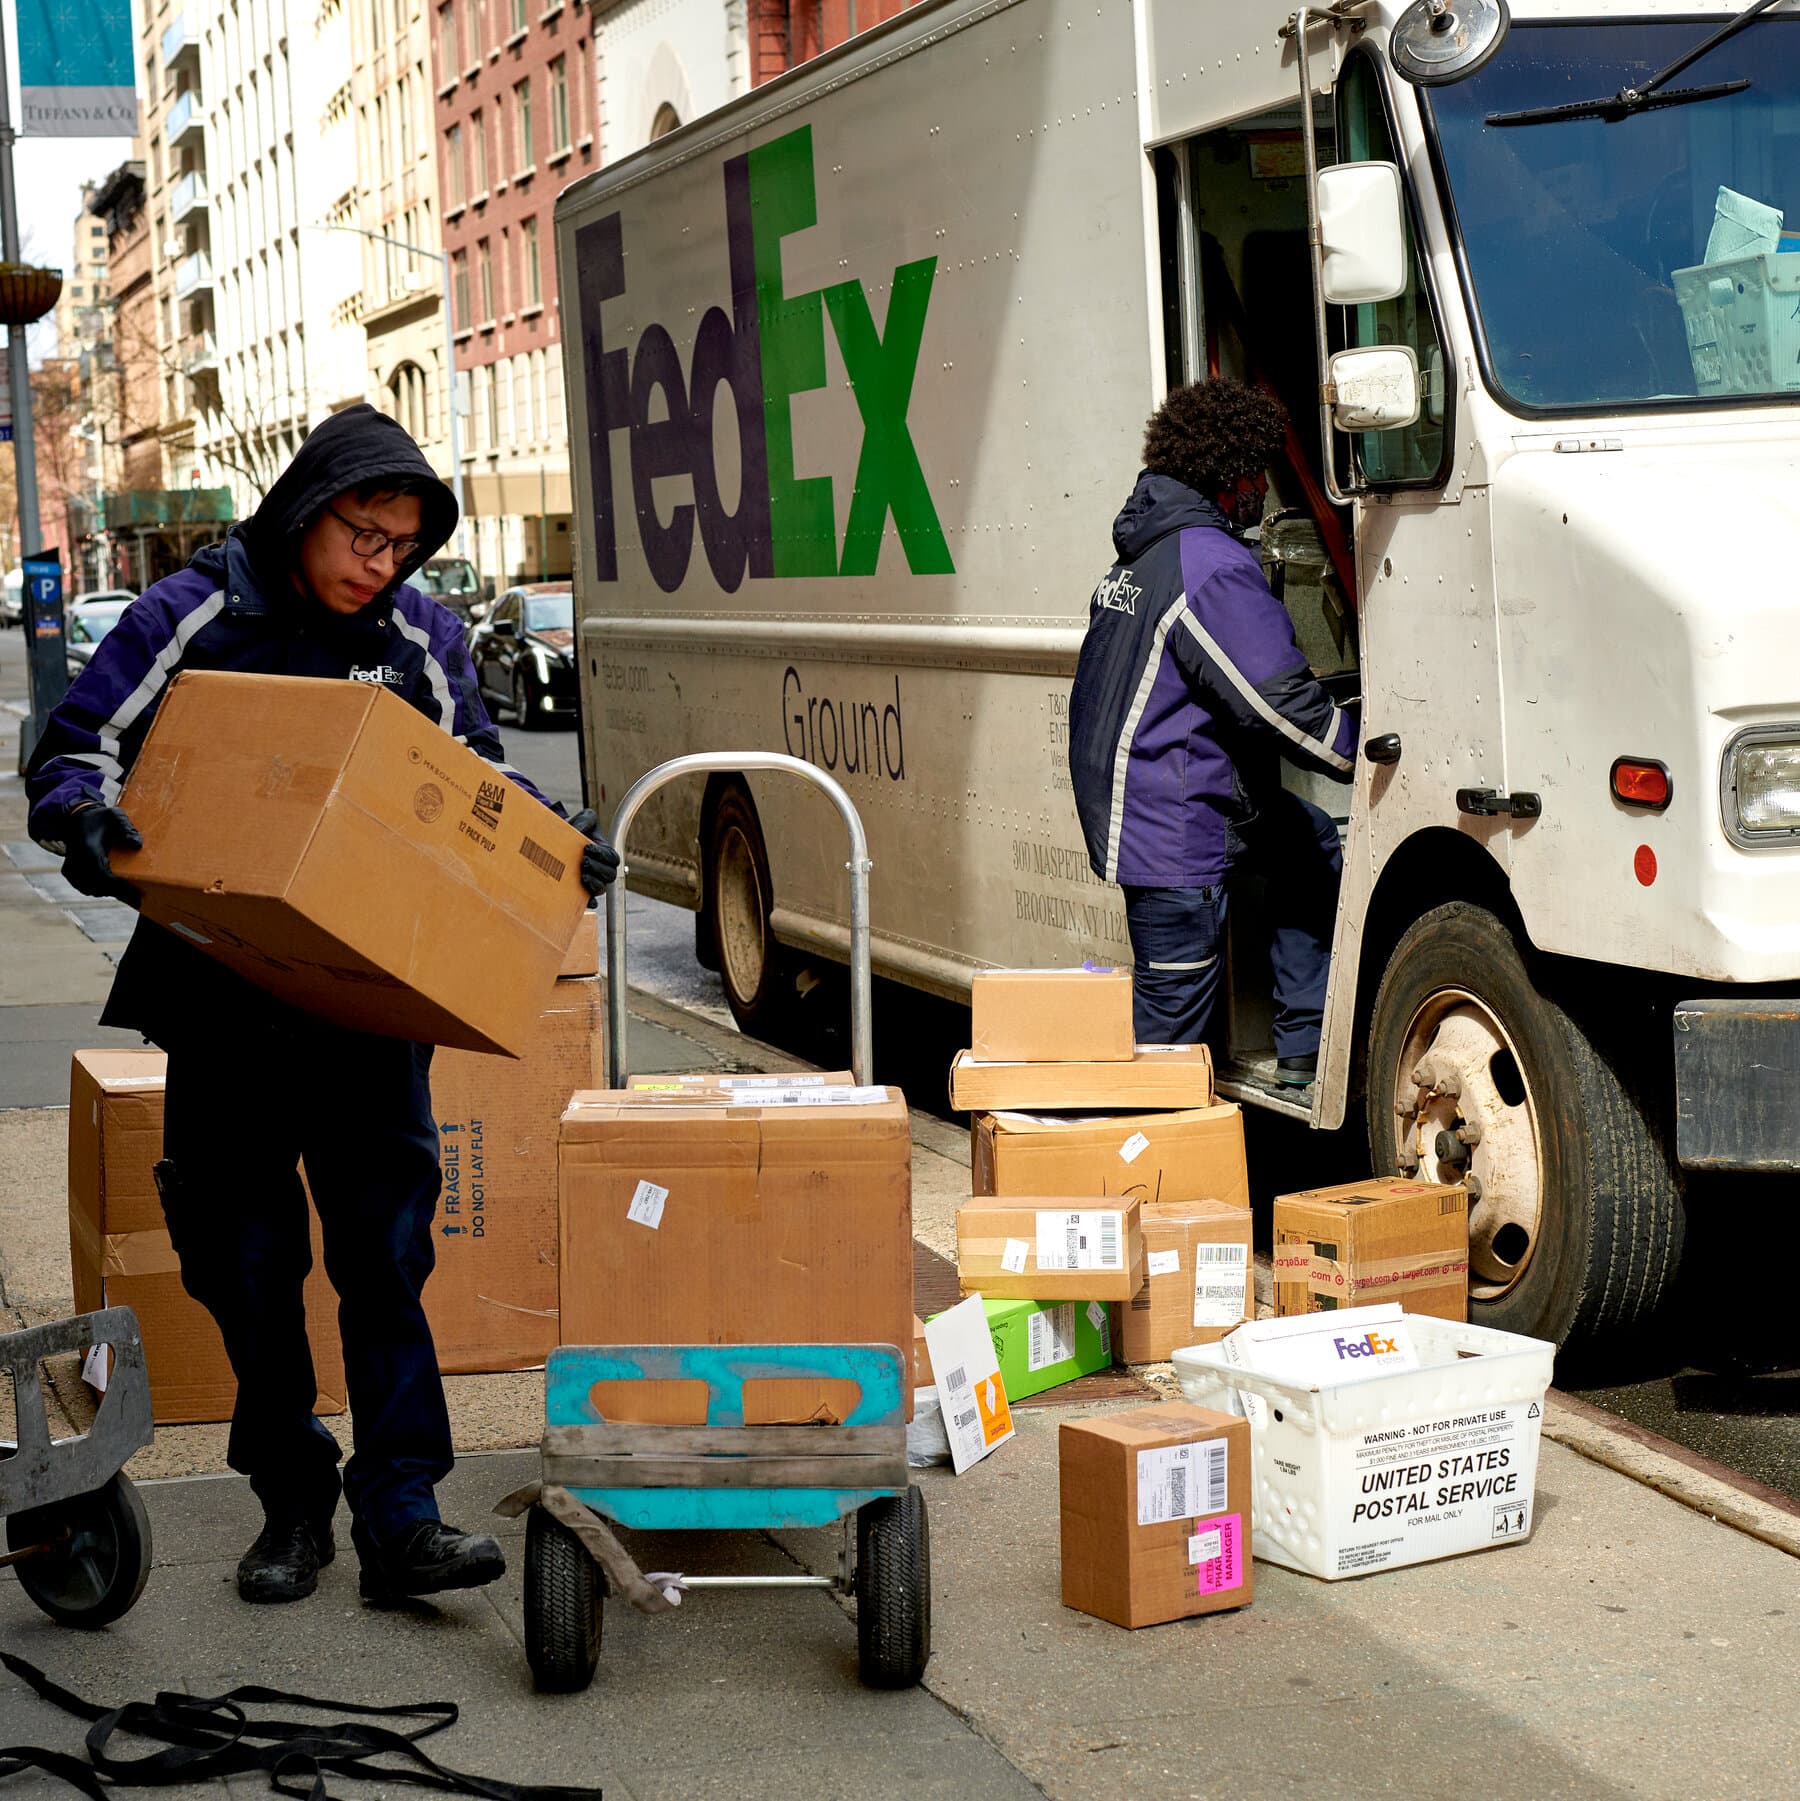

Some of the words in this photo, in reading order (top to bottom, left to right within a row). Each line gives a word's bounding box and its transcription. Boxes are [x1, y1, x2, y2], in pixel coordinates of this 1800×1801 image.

[575, 124, 956, 594] FedEx
[41, 578, 55, 600] P
[1096, 569, 1143, 616] edEx
[349, 664, 404, 685] FedEx
[783, 666, 905, 781] Ground
[478, 780, 506, 803] A&M
[459, 820, 467, 832] 12
[466, 826, 481, 842] PACK
[480, 836, 496, 853] PULP
[1012, 840, 1031, 872] 300
[1033, 844, 1089, 883] MASPETH
[1082, 904, 1099, 938] NY
[471, 1120, 483, 1149] FLAT
[445, 1145, 459, 1214] FRAGILE
[472, 1154, 484, 1178] LAY
[472, 1183, 484, 1211] NOT
[472, 1215, 484, 1237] DO
[1402, 1266, 1440, 1280] target.com
[1333, 1332, 1399, 1360] FedEx
[1364, 1428, 1406, 1445] WARNING
[1412, 1424, 1430, 1436] NOT
[1432, 1420, 1450, 1432] FOR
[1452, 1413, 1487, 1428] PRIVATE
[1489, 1410, 1506, 1421] USE
[1404, 1442, 1416, 1450] FOR
[1416, 1439, 1432, 1447] THEFT
[1468, 1429, 1487, 1438] POSTAL
[1487, 1423, 1513, 1433] PROPERTY
[1398, 1451, 1409, 1459] AND
[1430, 1440, 1468, 1453] IMPRISONMENT
[1361, 1463, 1432, 1494] UNITED
[1437, 1448, 1511, 1480] STATES
[1353, 1491, 1430, 1524] POSTAL
[1436, 1473, 1518, 1507] SERVICE
[1407, 1516, 1424, 1527] FOR
[1425, 1512, 1442, 1523] MAIL
[1443, 1508, 1463, 1520] ONLY
[1224, 1522, 1233, 1580] MANAGER
